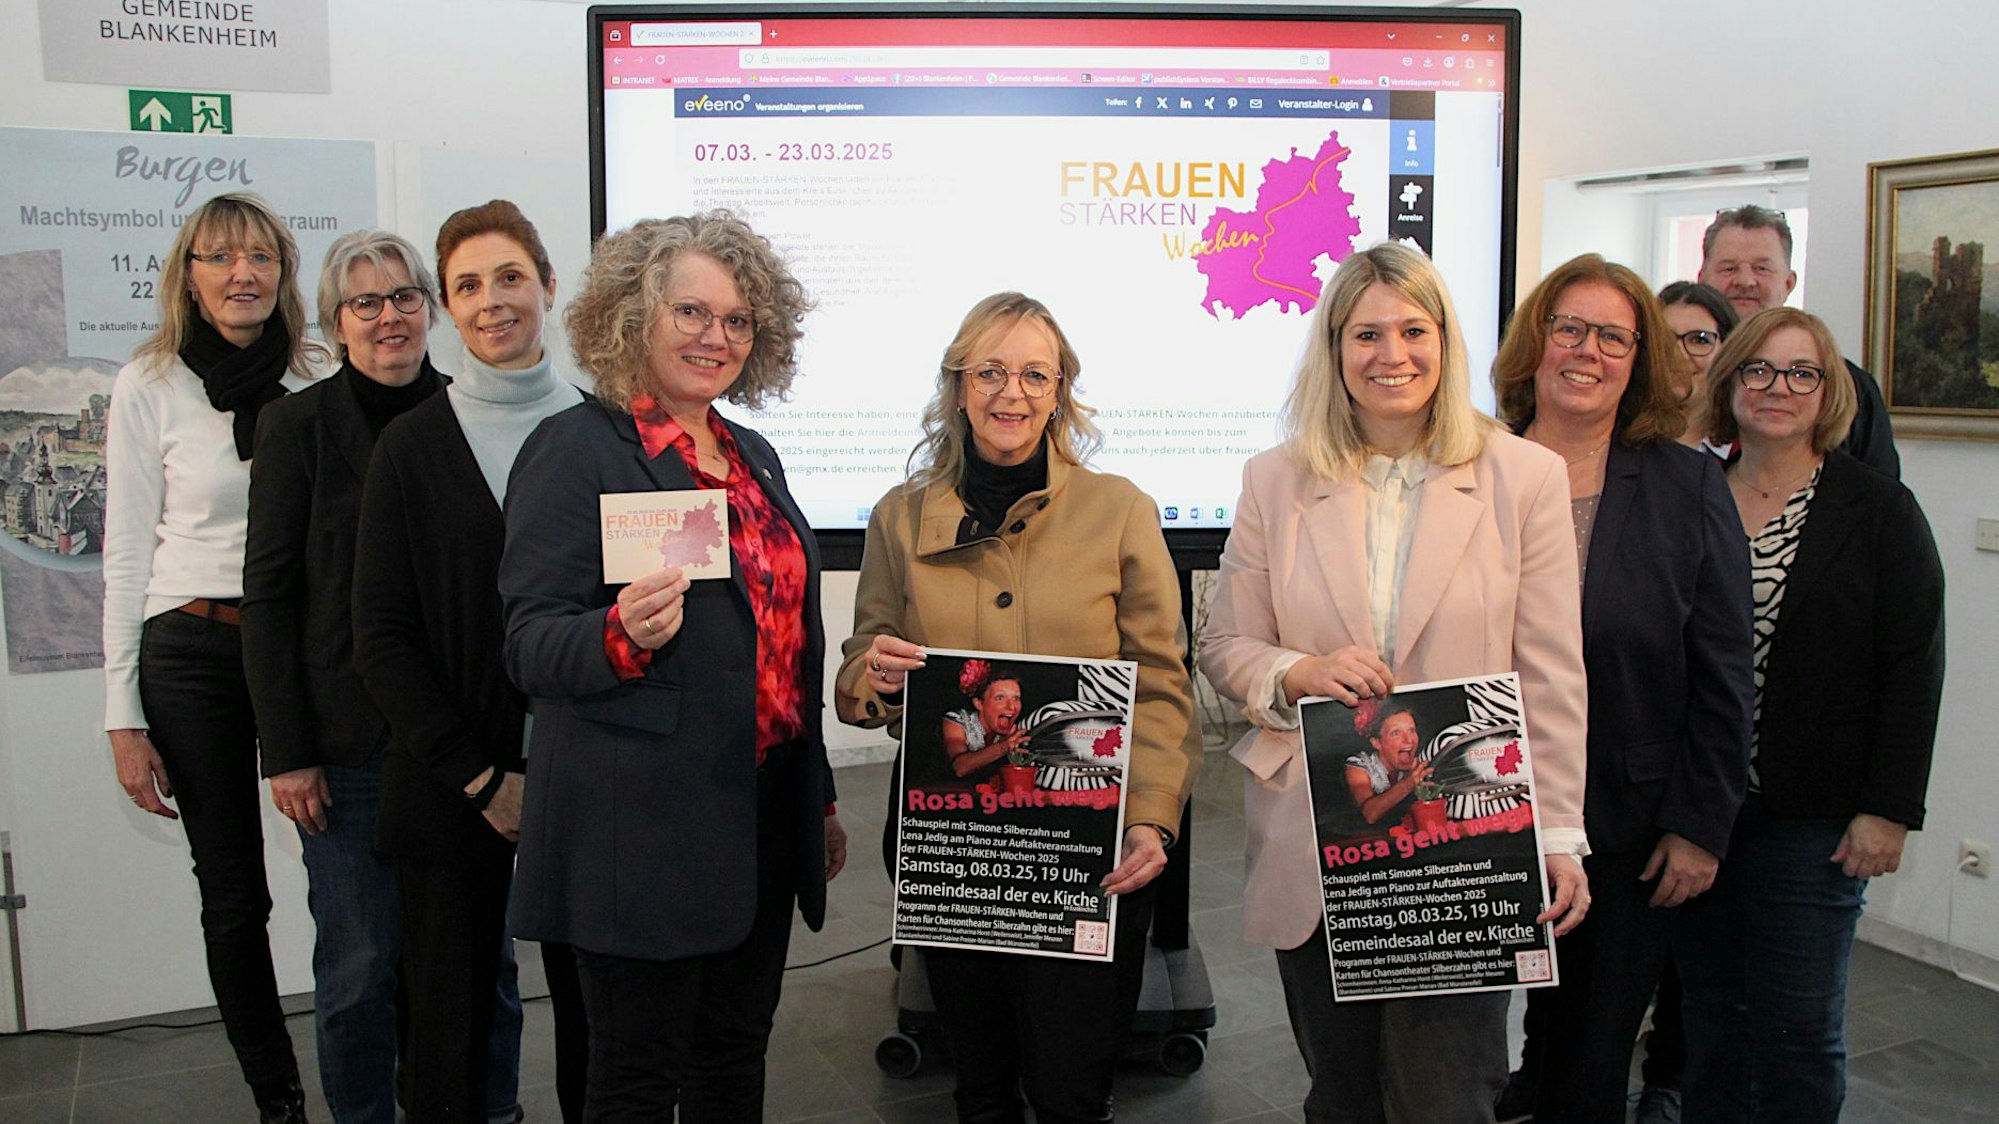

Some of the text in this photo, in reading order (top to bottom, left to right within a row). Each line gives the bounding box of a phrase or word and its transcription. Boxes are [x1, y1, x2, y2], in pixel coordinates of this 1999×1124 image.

[121, 0, 254, 22] GEMEINDE
[99, 19, 278, 48] BLANKENHEIM
[755, 102, 864, 113] Veranstaltungen organisieren
[1278, 98, 1359, 111] Veranstalter-Login
[694, 144, 758, 162] 07.03.
[778, 143, 893, 161] 23.03.2025
[1404, 160, 1419, 168] Info
[115, 145, 253, 209] Burgen
[1060, 161, 1245, 198] FRAUEN
[19, 205, 164, 233] Machtsymbol
[1059, 197, 1196, 226] STÄRKEN
[1397, 214, 1424, 222] Anreise
[1162, 221, 1259, 261] Wochen
[110, 254, 139, 272] 11.
[79, 321, 96, 331] Die
[99, 321, 138, 332] aktuelle
[806, 410, 855, 419] Interesse
[760, 428, 795, 437] halten
[815, 428, 836, 437] hier
[838, 428, 855, 437] die
[1112, 427, 1162, 438] Angebote
[1207, 427, 1222, 437] bis
[1224, 429, 1247, 437] zum
[779, 446, 803, 455] 2025
[805, 446, 865, 457] eingereicht
[1122, 446, 1148, 455] auch
[1149, 446, 1196, 457] jederzeit
[606, 512, 679, 529] FRAUEN
[907, 788, 974, 812] Rosa
[980, 784, 1046, 815] geht
[902, 816, 1070, 838] Schauspiel mit Simone Silberzahn und
[900, 842, 1059, 863] der FRAUEN-STÄRKEN-Wochen 2025
[901, 829, 1102, 855] Lena Jedig am Piano zur Auftaktveranstaltung
[1323, 839, 1391, 869] Rosa
[1396, 820, 1461, 859] geht
[900, 855, 1090, 883] Samstag, 08.03.25, 19 Uhr
[1322, 858, 1492, 885] Schauspiel mit Simone Silberzahn und
[898, 878, 1001, 900] Gemeindesaal
[1003, 885, 1027, 902] der
[1031, 891, 1051, 904] ev.
[1053, 889, 1098, 908] Kirche
[1324, 871, 1527, 898] Lena Jedig am Piano zur Auftaktveranstaltung
[897, 900, 1064, 921] Programm der FRAUEN-STÄRKEN-Wochen und
[1326, 888, 1486, 912] der FRAUEN-STÄRKEN-Wochen 2025
[896, 913, 1074, 935] Karten für Chansontheater Silberzahn gibt es hier:
[1328, 899, 1520, 930] Samstag, 08.03.25, 19 Uhr
[1331, 922, 1534, 952] Gemeindesaal der ev. Kirche
[1333, 946, 1501, 968] Programm der FRAUEN-STÄRKEN-Wochen und
[1334, 971, 1360, 980] Karten
[1360, 969, 1371, 978] für
[1372, 966, 1430, 977] Chansontheater
[1430, 962, 1471, 973] Silberzahn
[1471, 960, 1487, 972] gibt
[1487, 961, 1497, 969] es
[1497, 958, 1515, 968] hier:
